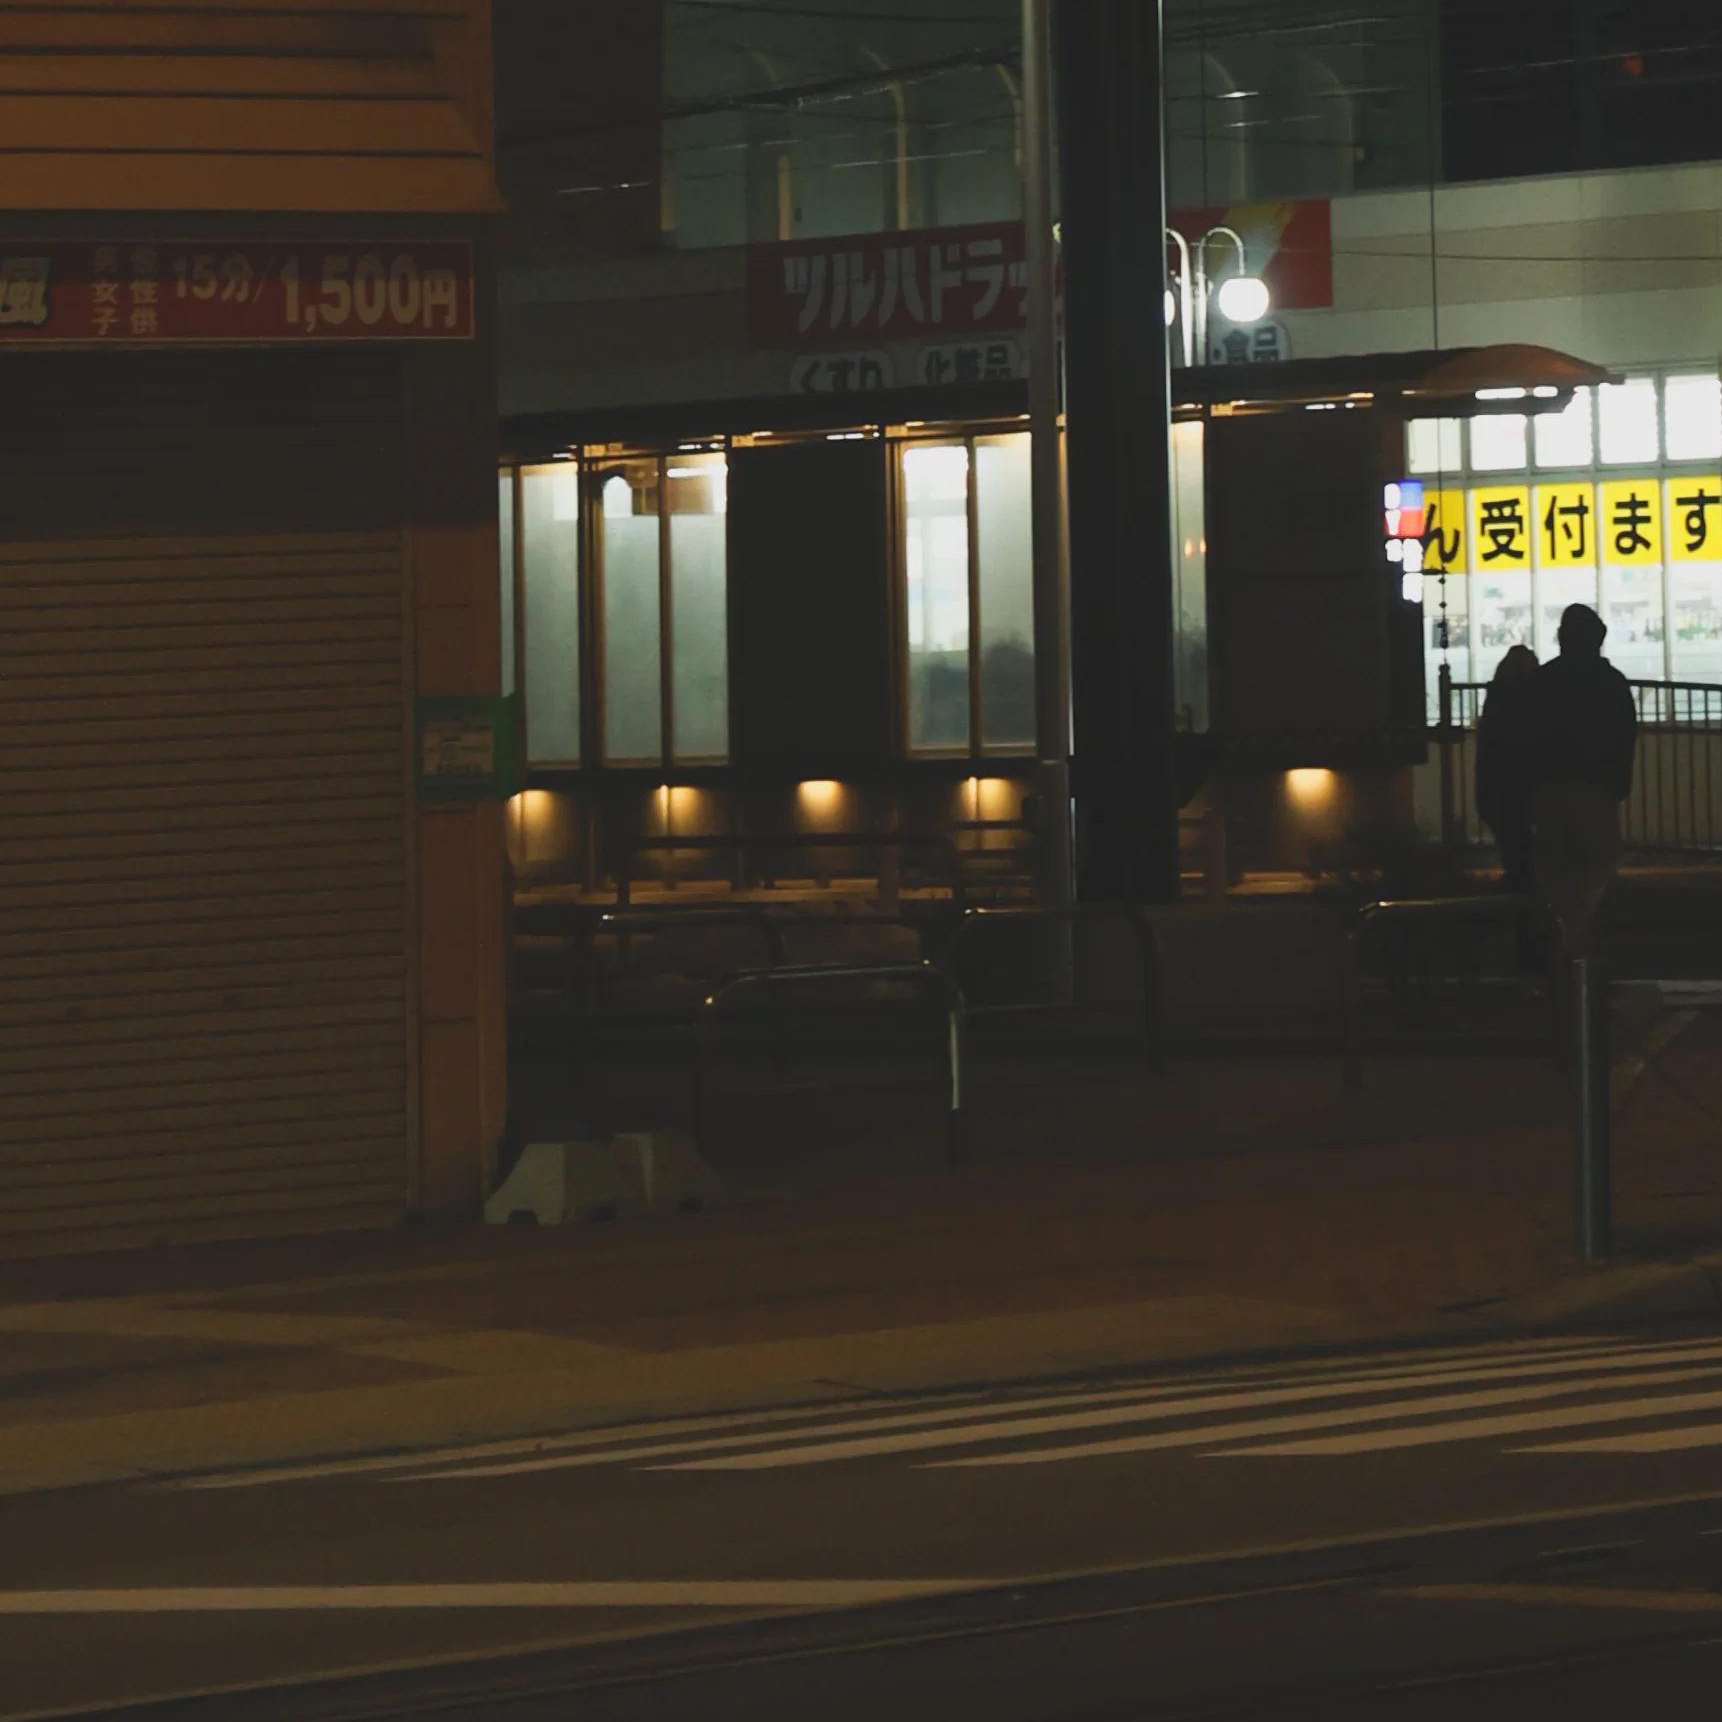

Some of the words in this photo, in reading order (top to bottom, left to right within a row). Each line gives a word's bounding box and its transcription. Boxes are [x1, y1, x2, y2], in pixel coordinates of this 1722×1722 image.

[782, 238, 1029, 335] ツルハドラ
